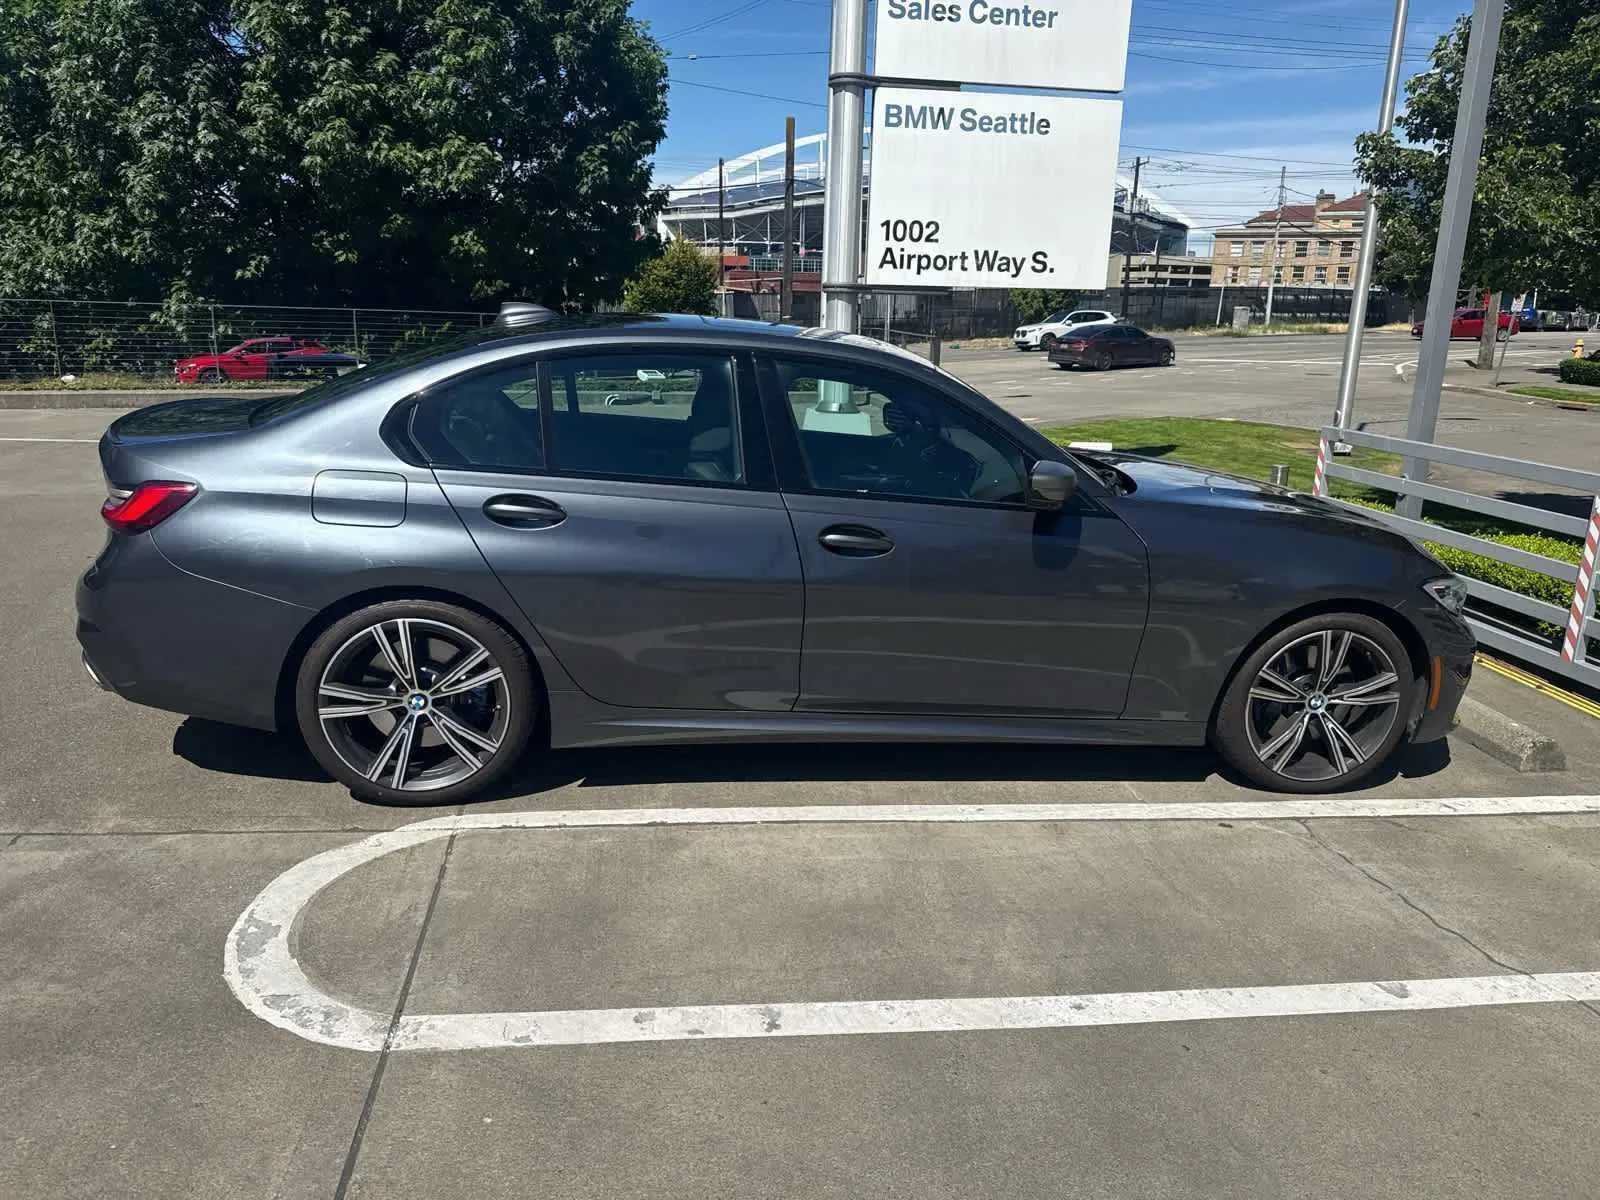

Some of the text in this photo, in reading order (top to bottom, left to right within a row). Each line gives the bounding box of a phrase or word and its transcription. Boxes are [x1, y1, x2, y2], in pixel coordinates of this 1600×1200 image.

[887, 0, 1059, 29] Sales Center
[884, 103, 1051, 136] BMW Seattle
[879, 219, 940, 244] 1002
[878, 247, 1055, 279] Airport Way S.
